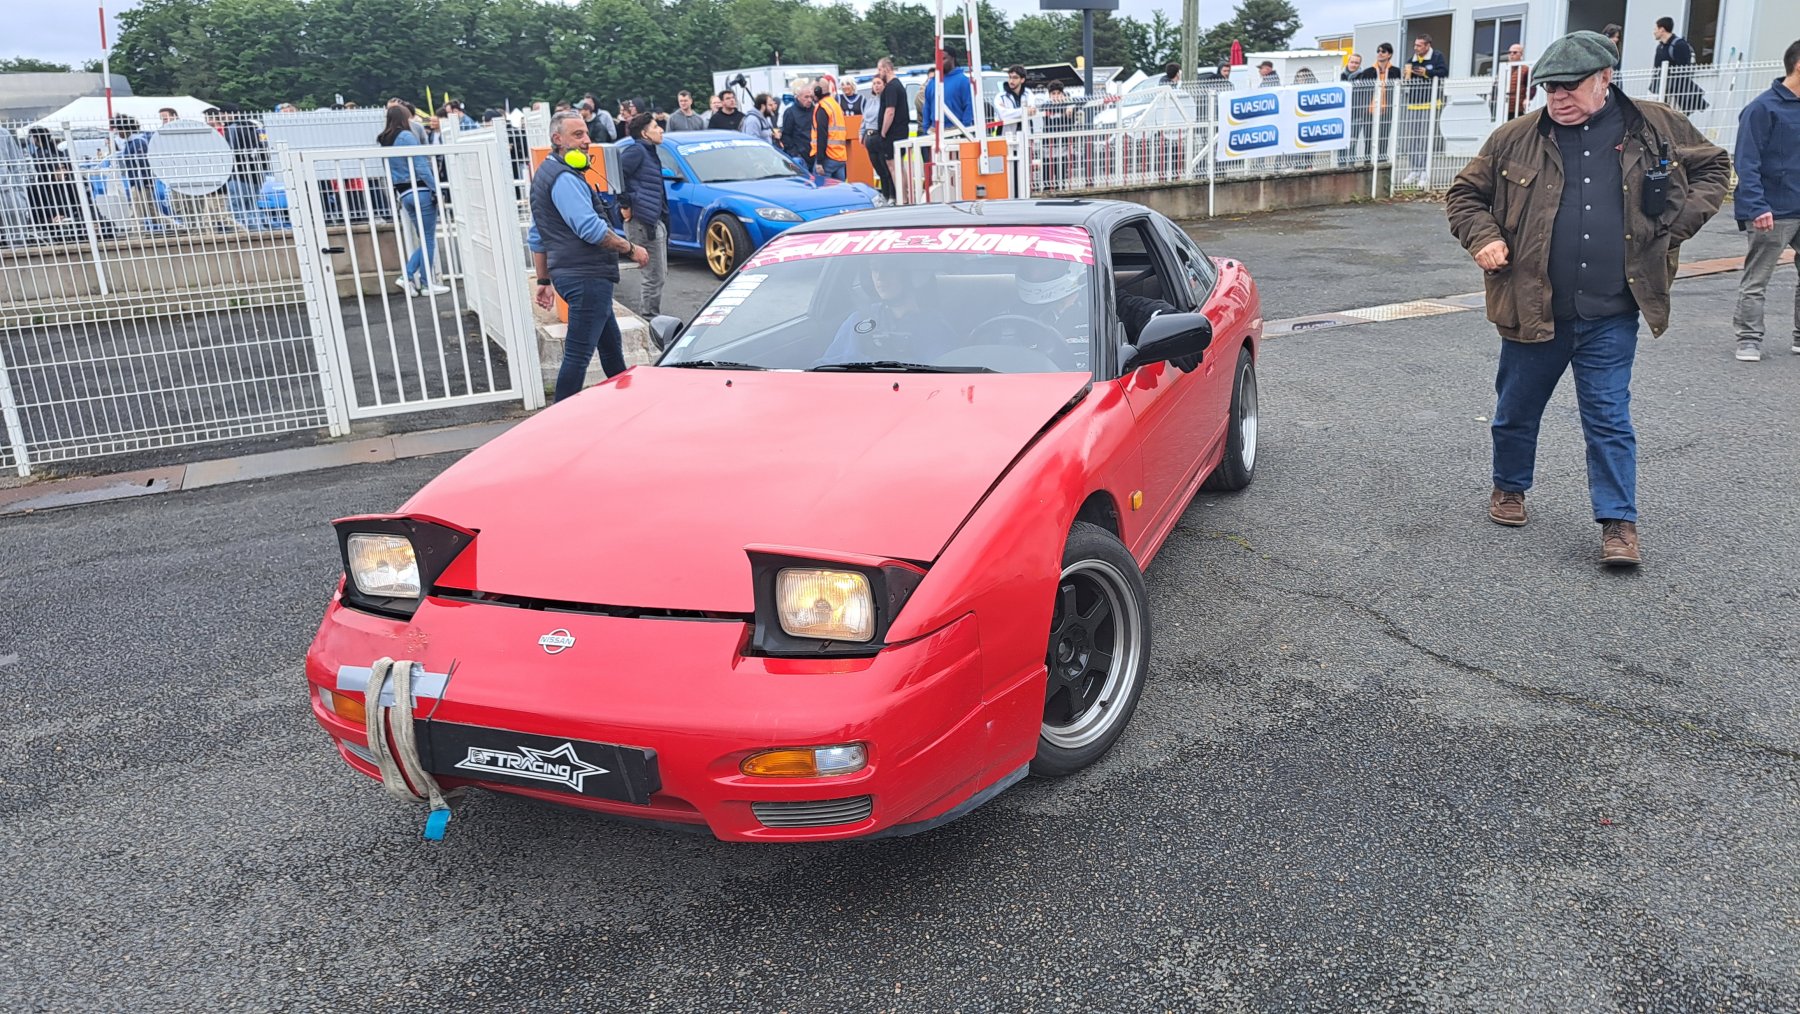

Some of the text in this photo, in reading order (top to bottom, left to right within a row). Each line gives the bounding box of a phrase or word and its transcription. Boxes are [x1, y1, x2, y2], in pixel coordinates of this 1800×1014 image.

[1233, 99, 1275, 114] EVASION
[1300, 92, 1342, 106] EVASION
[1230, 130, 1275, 146] EVASION
[1301, 123, 1342, 138] EVASION
[812, 227, 1041, 256] Drift Show
[541, 636, 573, 646] NISSAN
